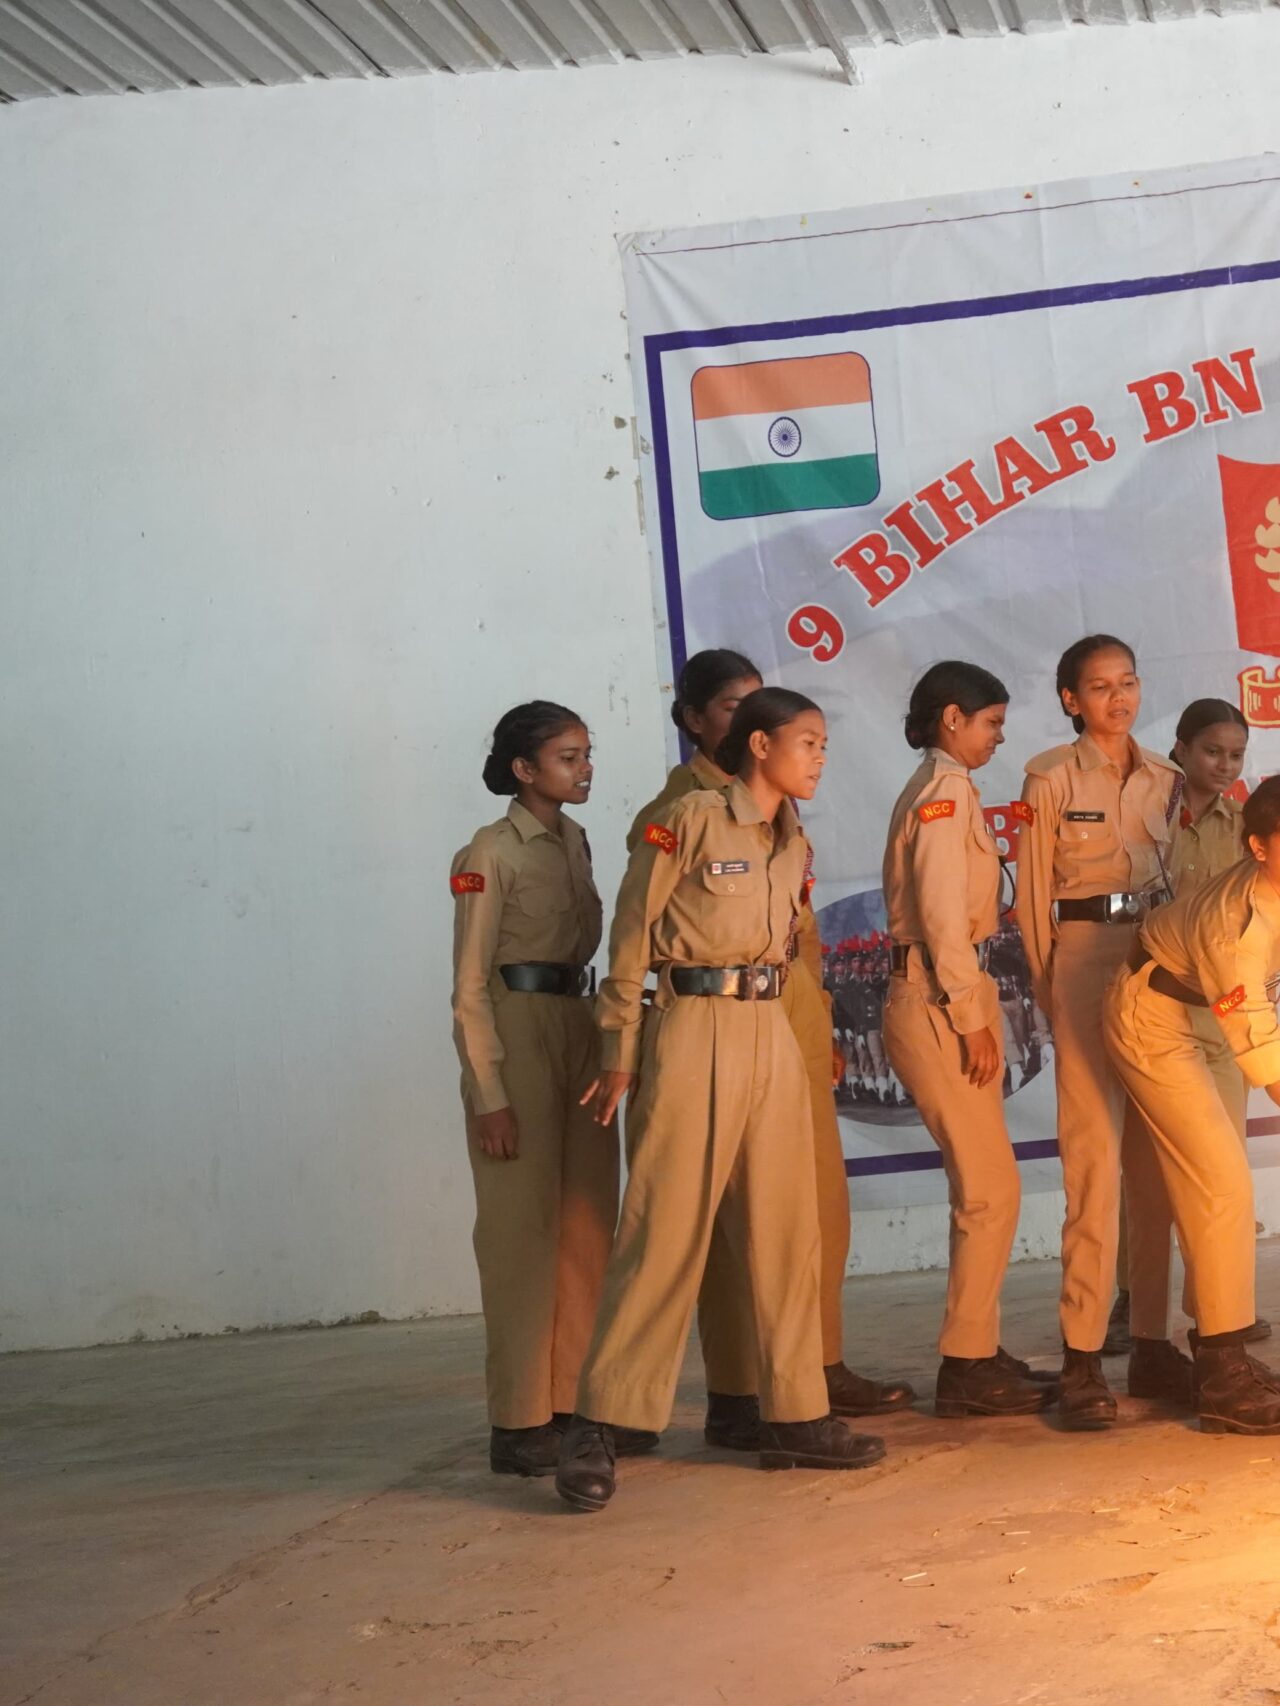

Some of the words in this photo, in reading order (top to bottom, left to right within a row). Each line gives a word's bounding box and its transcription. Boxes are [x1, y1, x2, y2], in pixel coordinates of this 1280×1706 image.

[786, 603, 845, 664] 9
[833, 405, 1118, 608] BIHAR
[1127, 347, 1264, 444] BN
[923, 802, 951, 819] NCC
[650, 828, 673, 848] NCC
[457, 875, 481, 889] NCC
[1219, 991, 1241, 1013] NCC
